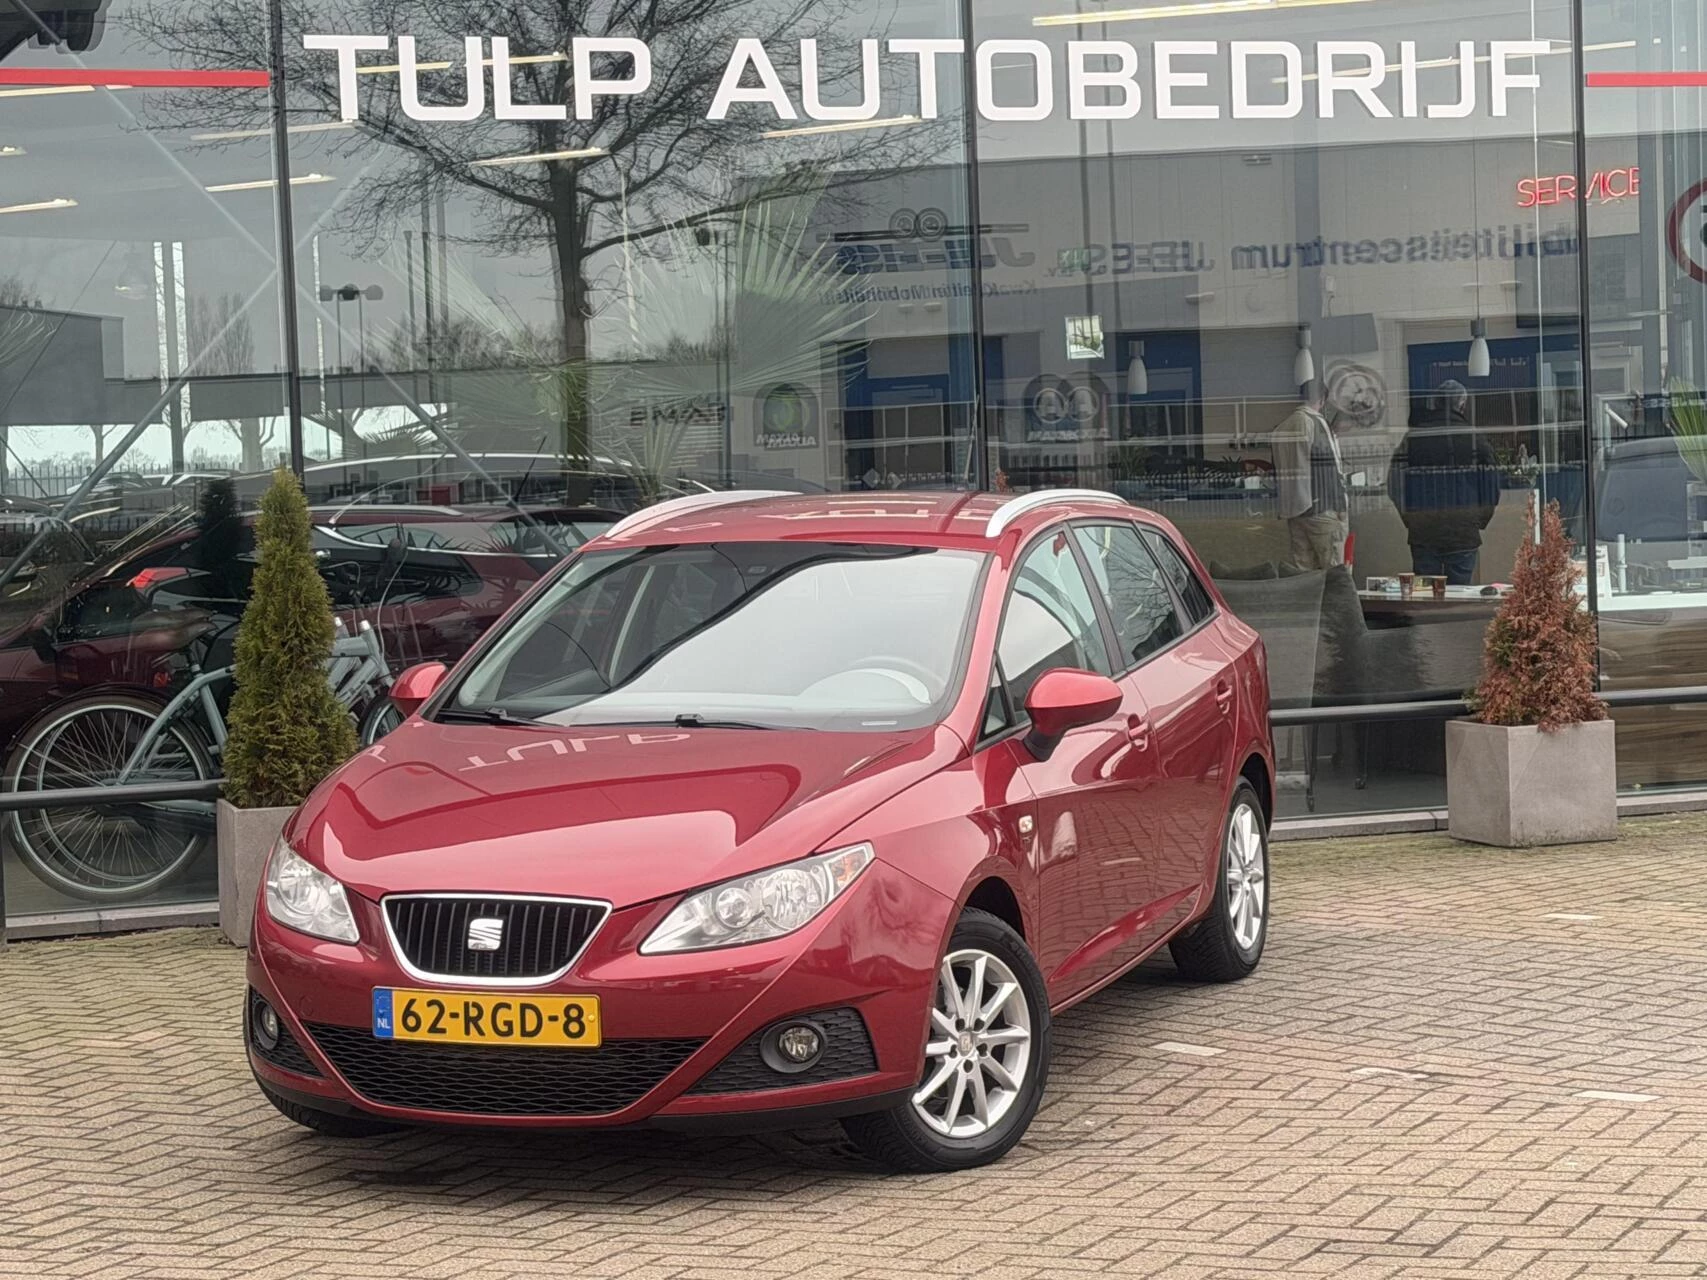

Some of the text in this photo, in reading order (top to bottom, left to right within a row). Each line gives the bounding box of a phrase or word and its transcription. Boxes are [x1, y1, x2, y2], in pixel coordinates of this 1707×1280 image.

[303, 34, 1551, 121] TULP AUTOBEDRIJF
[377, 998, 586, 1039] NL 62-RGD-8
